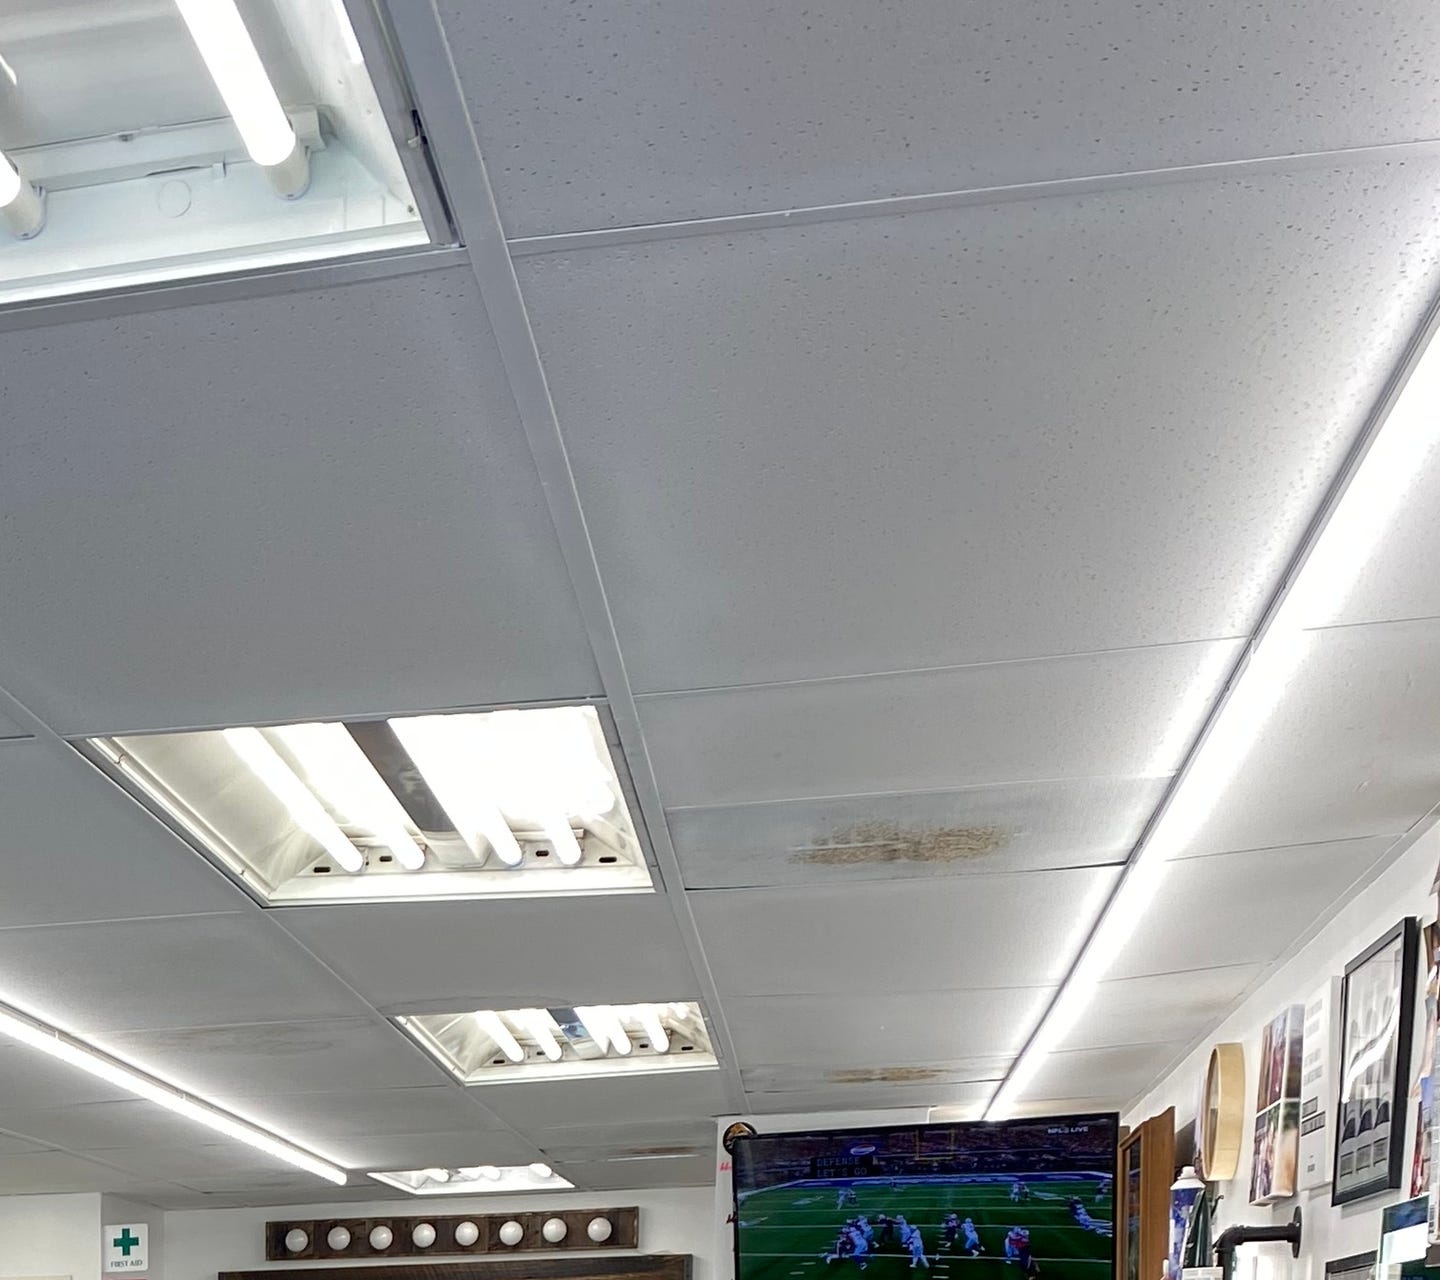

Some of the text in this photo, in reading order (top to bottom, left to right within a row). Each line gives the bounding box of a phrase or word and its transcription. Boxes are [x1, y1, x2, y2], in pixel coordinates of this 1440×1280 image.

[816, 1157, 861, 1167] DEFENSE
[110, 1258, 144, 1268] FIRST AID
